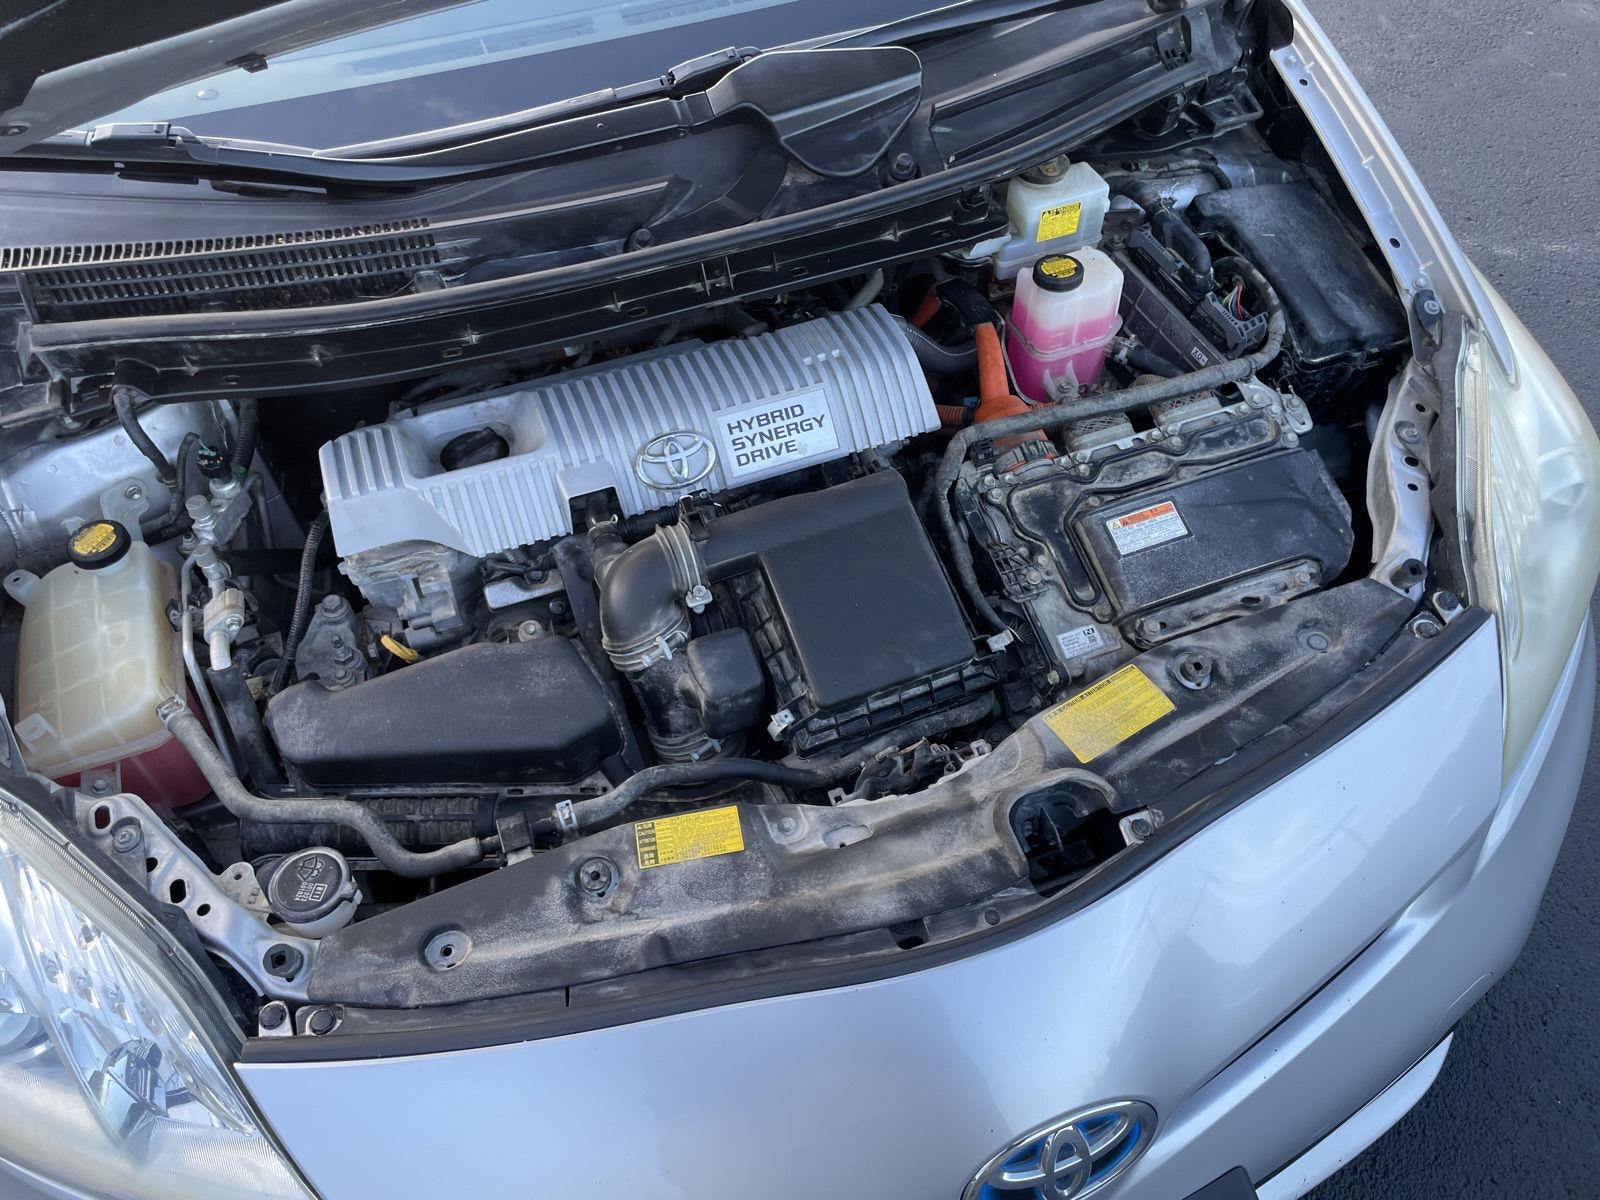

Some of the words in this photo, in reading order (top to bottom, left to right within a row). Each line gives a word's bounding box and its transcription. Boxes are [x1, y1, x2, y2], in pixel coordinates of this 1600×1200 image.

[727, 404, 804, 435] HYBRID
[732, 414, 825, 451] SYNERGY
[736, 440, 798, 467] DRIVE
